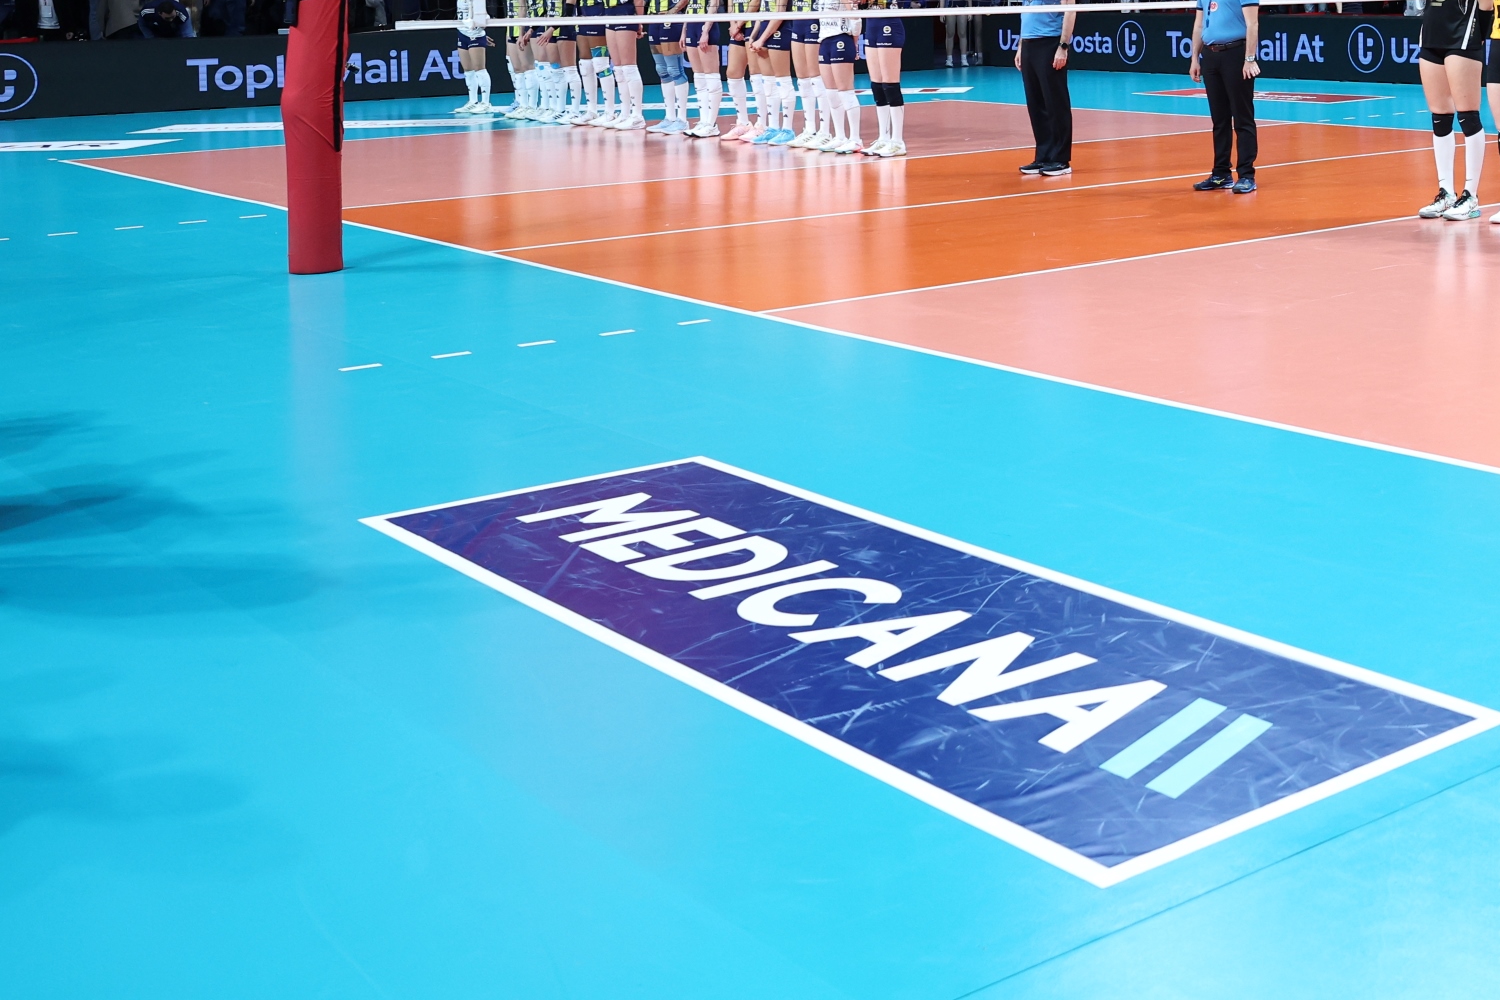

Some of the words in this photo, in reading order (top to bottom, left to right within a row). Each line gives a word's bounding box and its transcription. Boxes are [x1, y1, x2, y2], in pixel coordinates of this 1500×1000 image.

[1292, 33, 1325, 64] At
[186, 54, 285, 99] Topl
[517, 491, 1168, 755] MEDICANA
